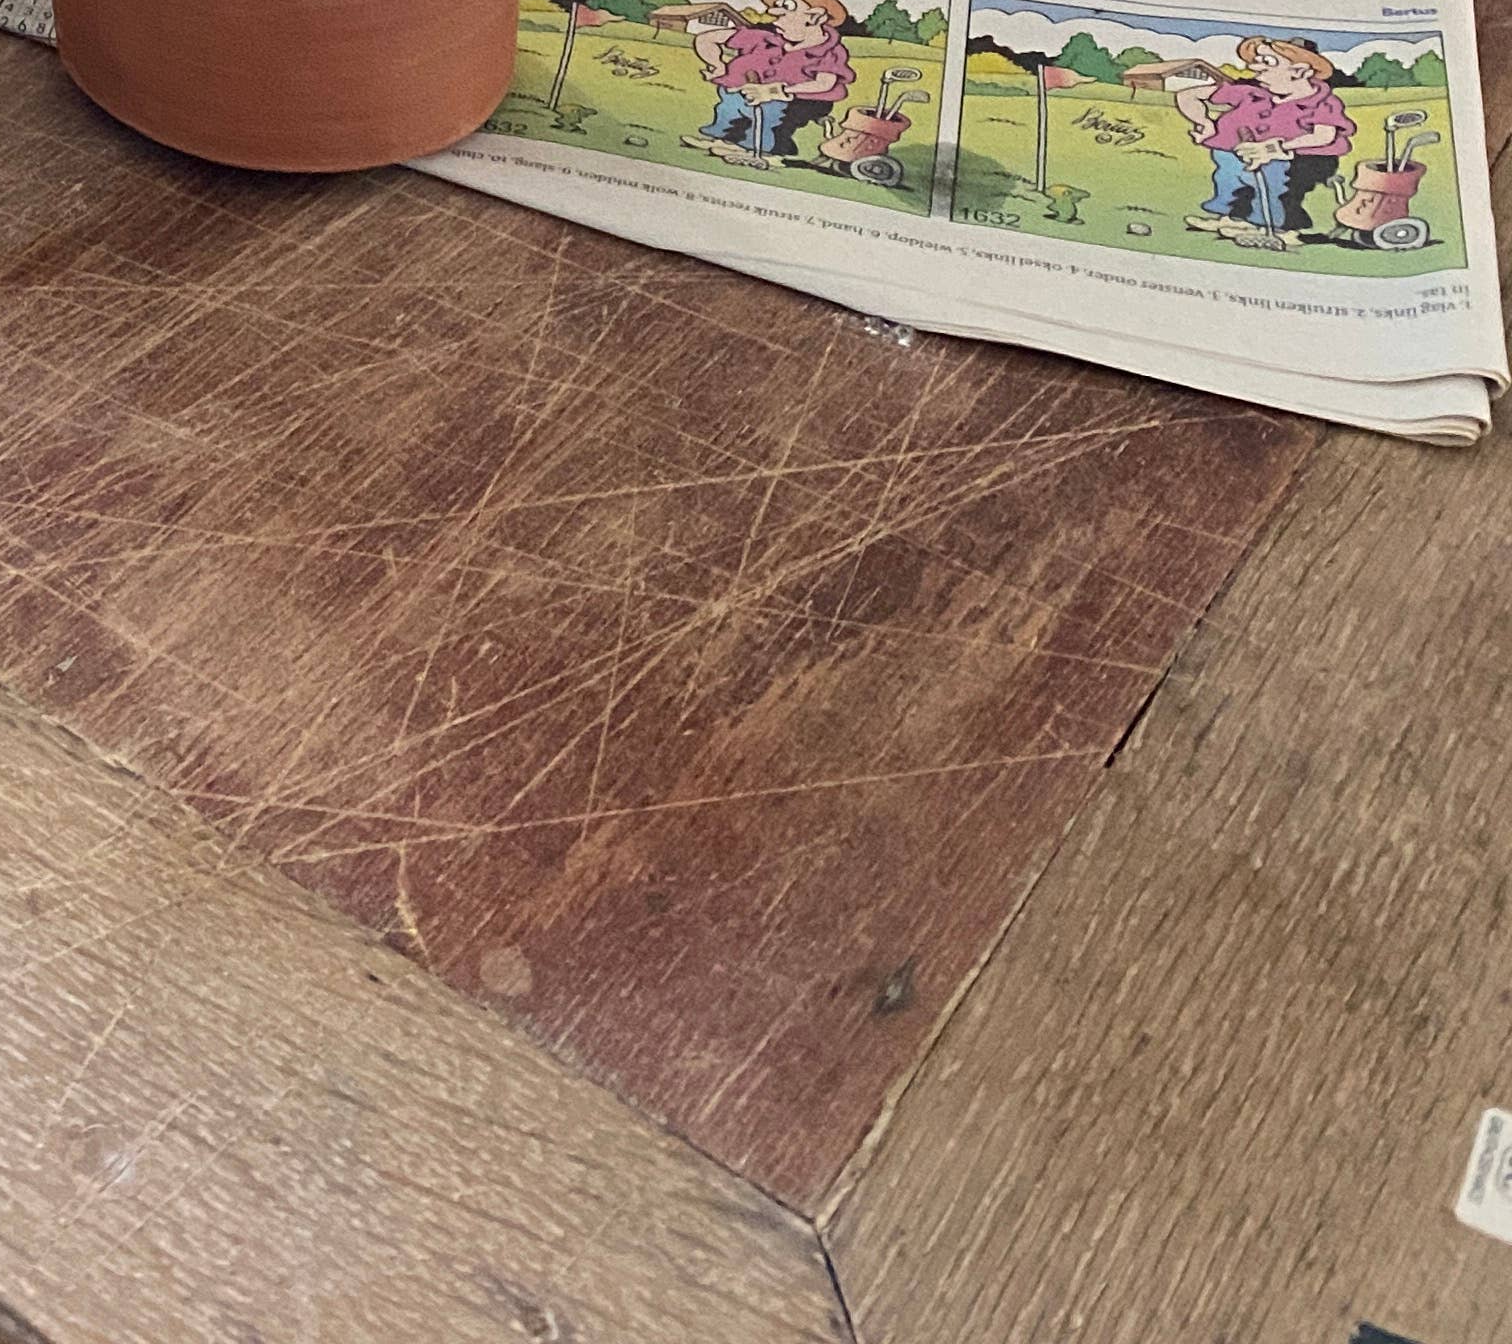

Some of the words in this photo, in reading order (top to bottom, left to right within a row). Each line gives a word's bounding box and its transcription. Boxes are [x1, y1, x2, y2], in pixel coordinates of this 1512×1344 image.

[18, 19, 27, 32] 6
[958, 207, 1021, 228] 1632
[1018, 255, 1063, 272] oksel
[1140, 279, 1205, 299] venster
[1274, 299, 1349, 317] struiken
[1419, 301, 1456, 313] vlag
